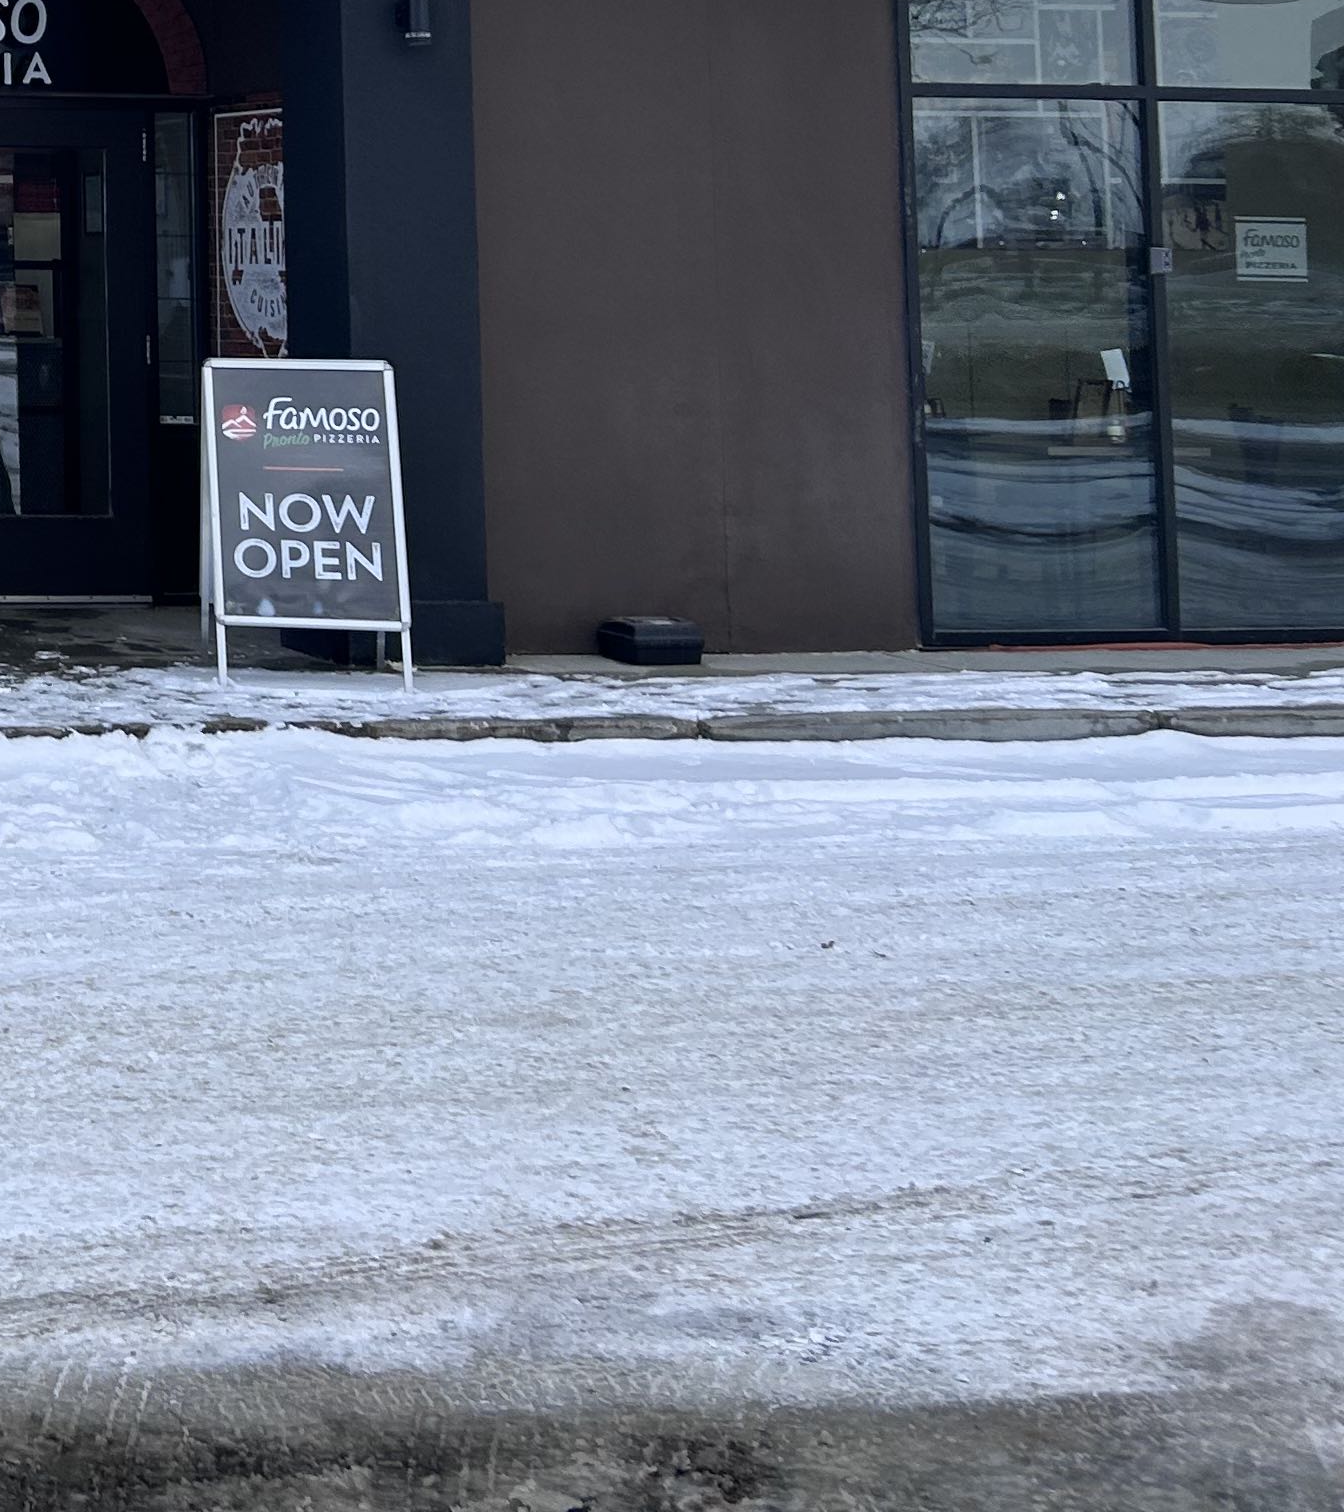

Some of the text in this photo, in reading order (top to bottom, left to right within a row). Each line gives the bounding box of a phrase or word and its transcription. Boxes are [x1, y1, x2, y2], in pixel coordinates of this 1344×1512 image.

[229, 227, 285, 265] ITALI
[263, 431, 381, 449] Pronto PIZZERIA
[238, 491, 376, 535] NOW
[233, 537, 384, 582] OPEN
